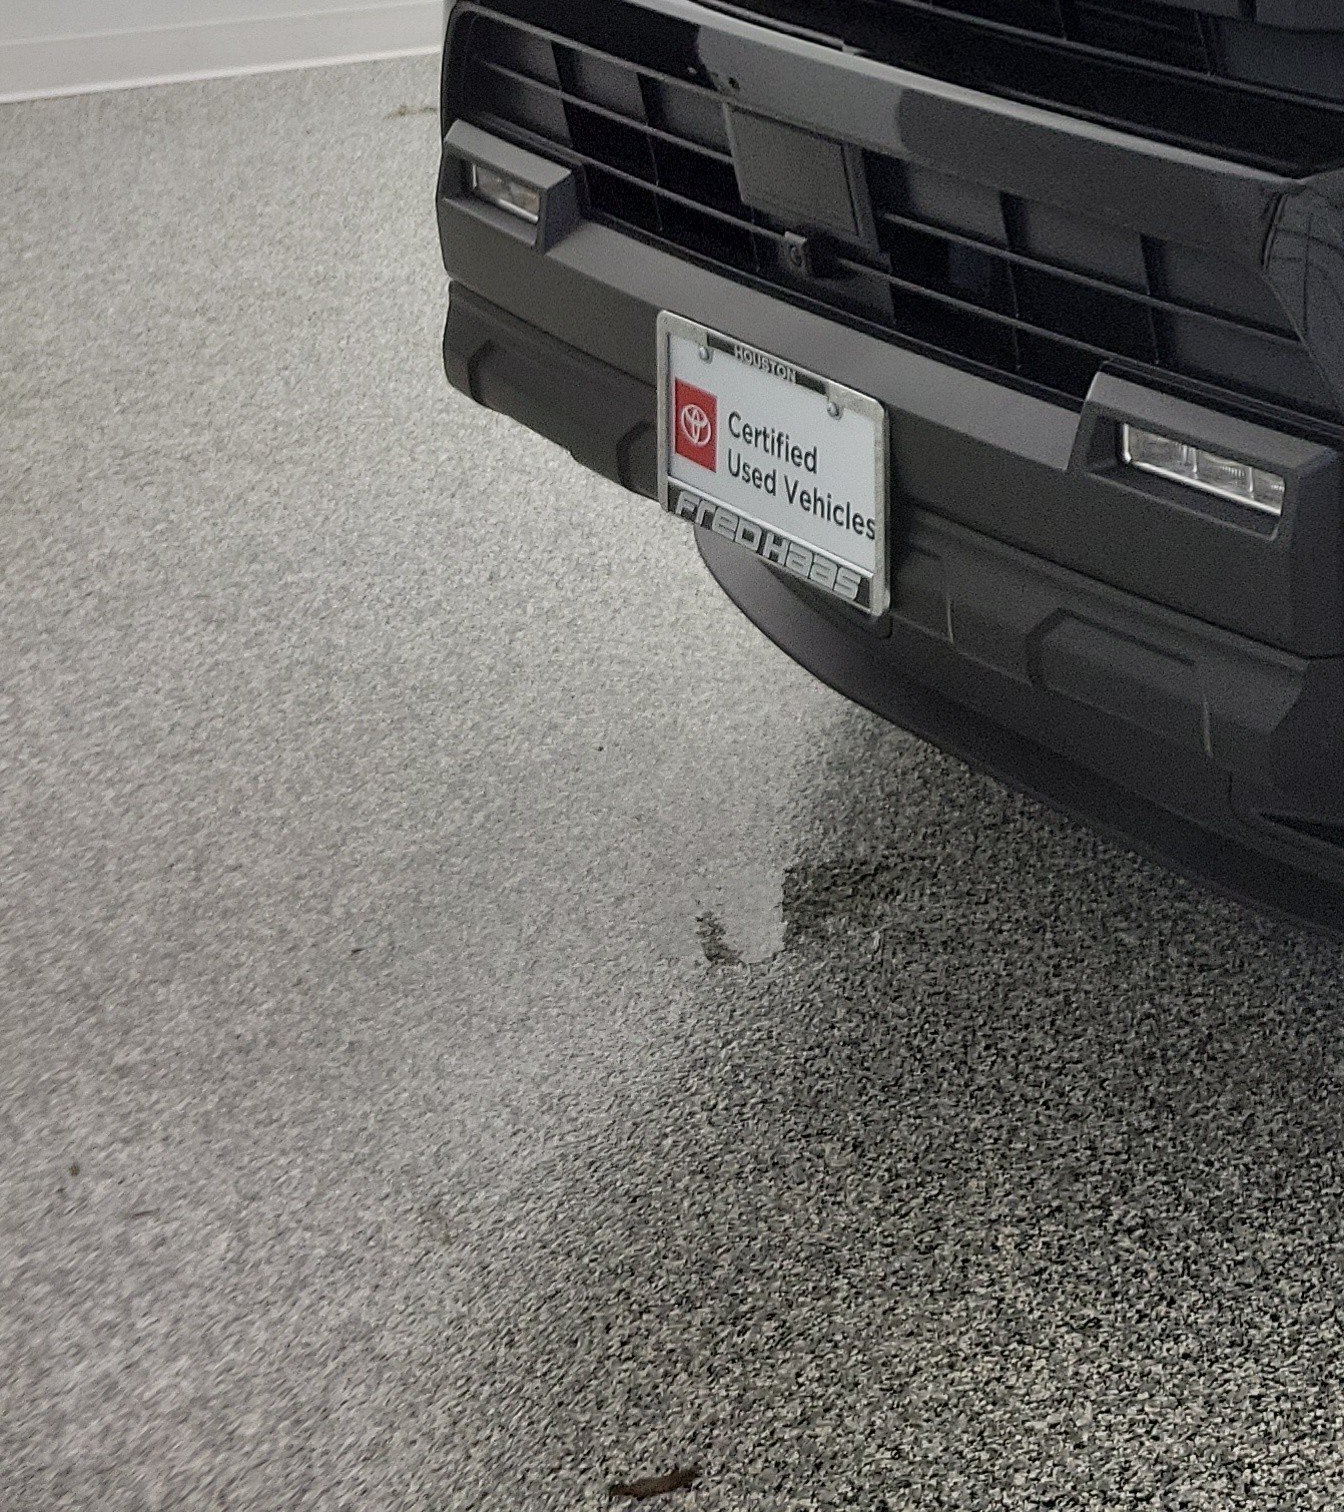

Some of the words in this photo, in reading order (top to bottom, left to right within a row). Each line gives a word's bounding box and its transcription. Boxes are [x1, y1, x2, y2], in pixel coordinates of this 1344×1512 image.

[734, 345, 797, 382] HOUSTON
[728, 410, 817, 474] Certified
[727, 448, 777, 496] Used
[784, 475, 876, 540] Vehicles
